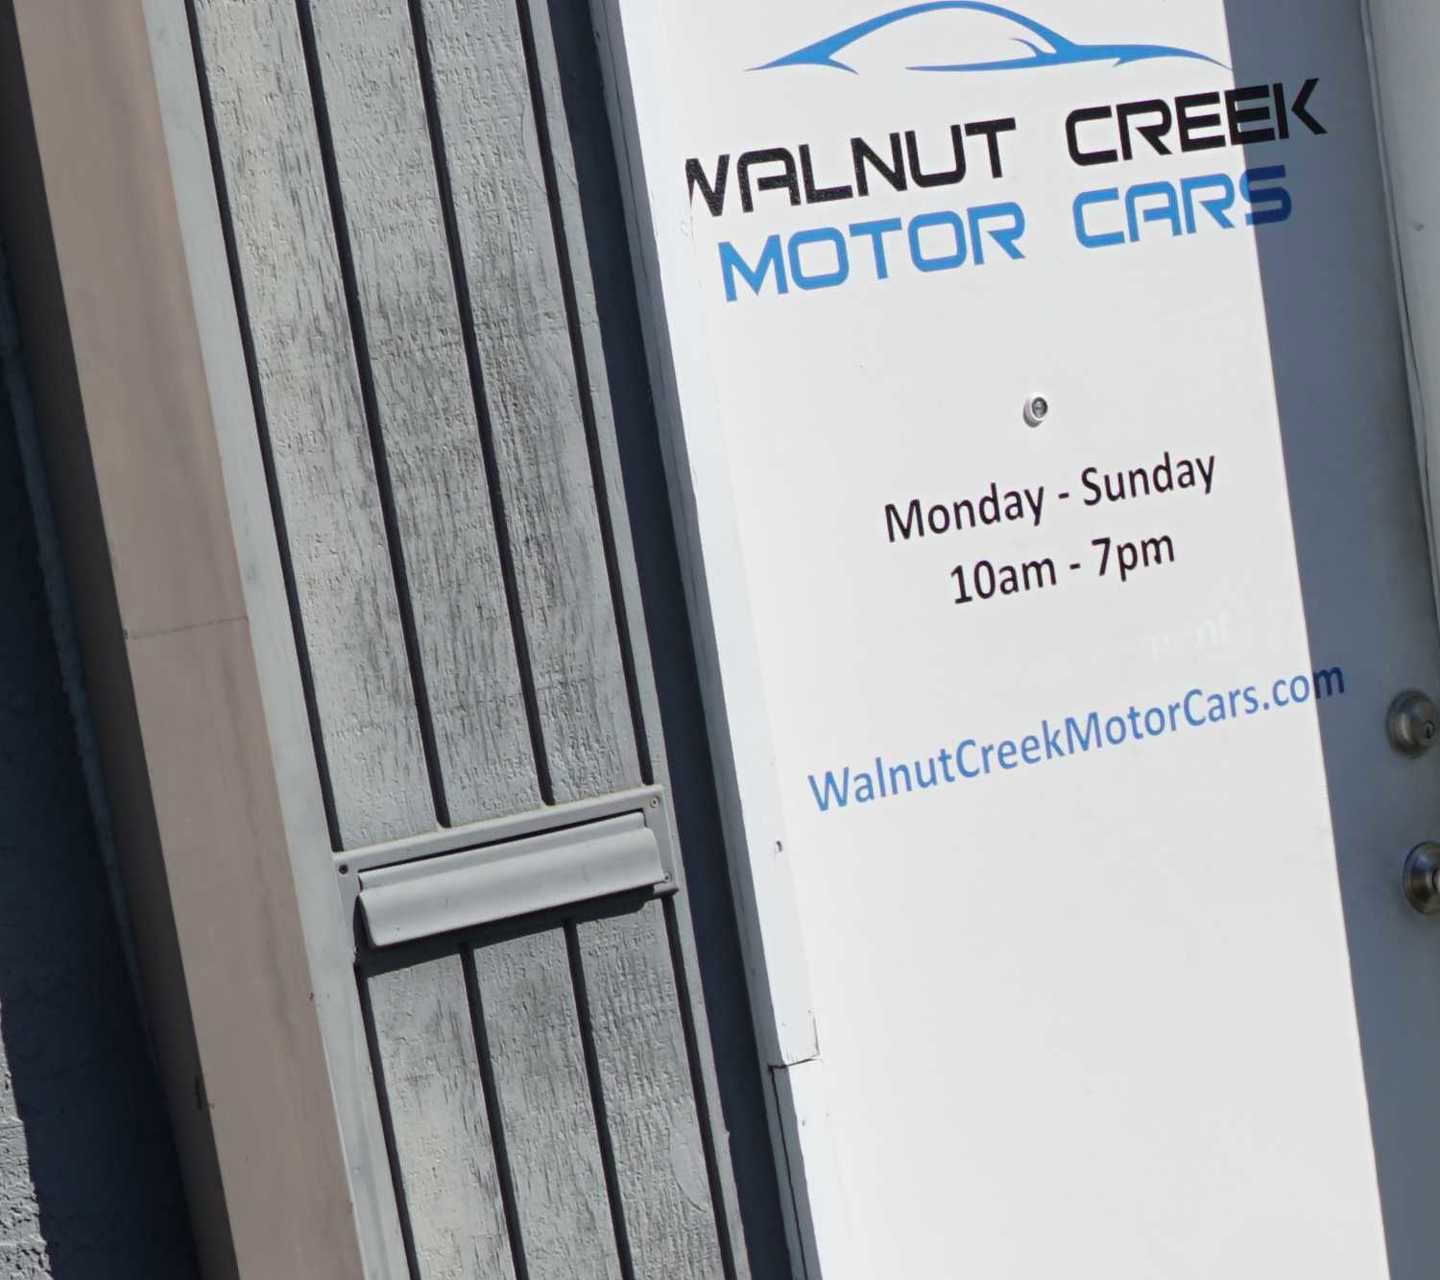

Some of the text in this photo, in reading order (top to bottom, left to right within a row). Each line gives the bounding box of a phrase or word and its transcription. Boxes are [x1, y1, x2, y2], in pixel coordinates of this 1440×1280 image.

[1066, 78, 1327, 167] CREEK
[717, 165, 1293, 302] MOTOR CARS
[884, 478, 1046, 544] Monday
[1081, 450, 1217, 508] Sunday
[948, 556, 1058, 604] 10am
[1091, 532, 1176, 588] 7pm
[807, 663, 1346, 813] WalnutCreekMotorCars.com
